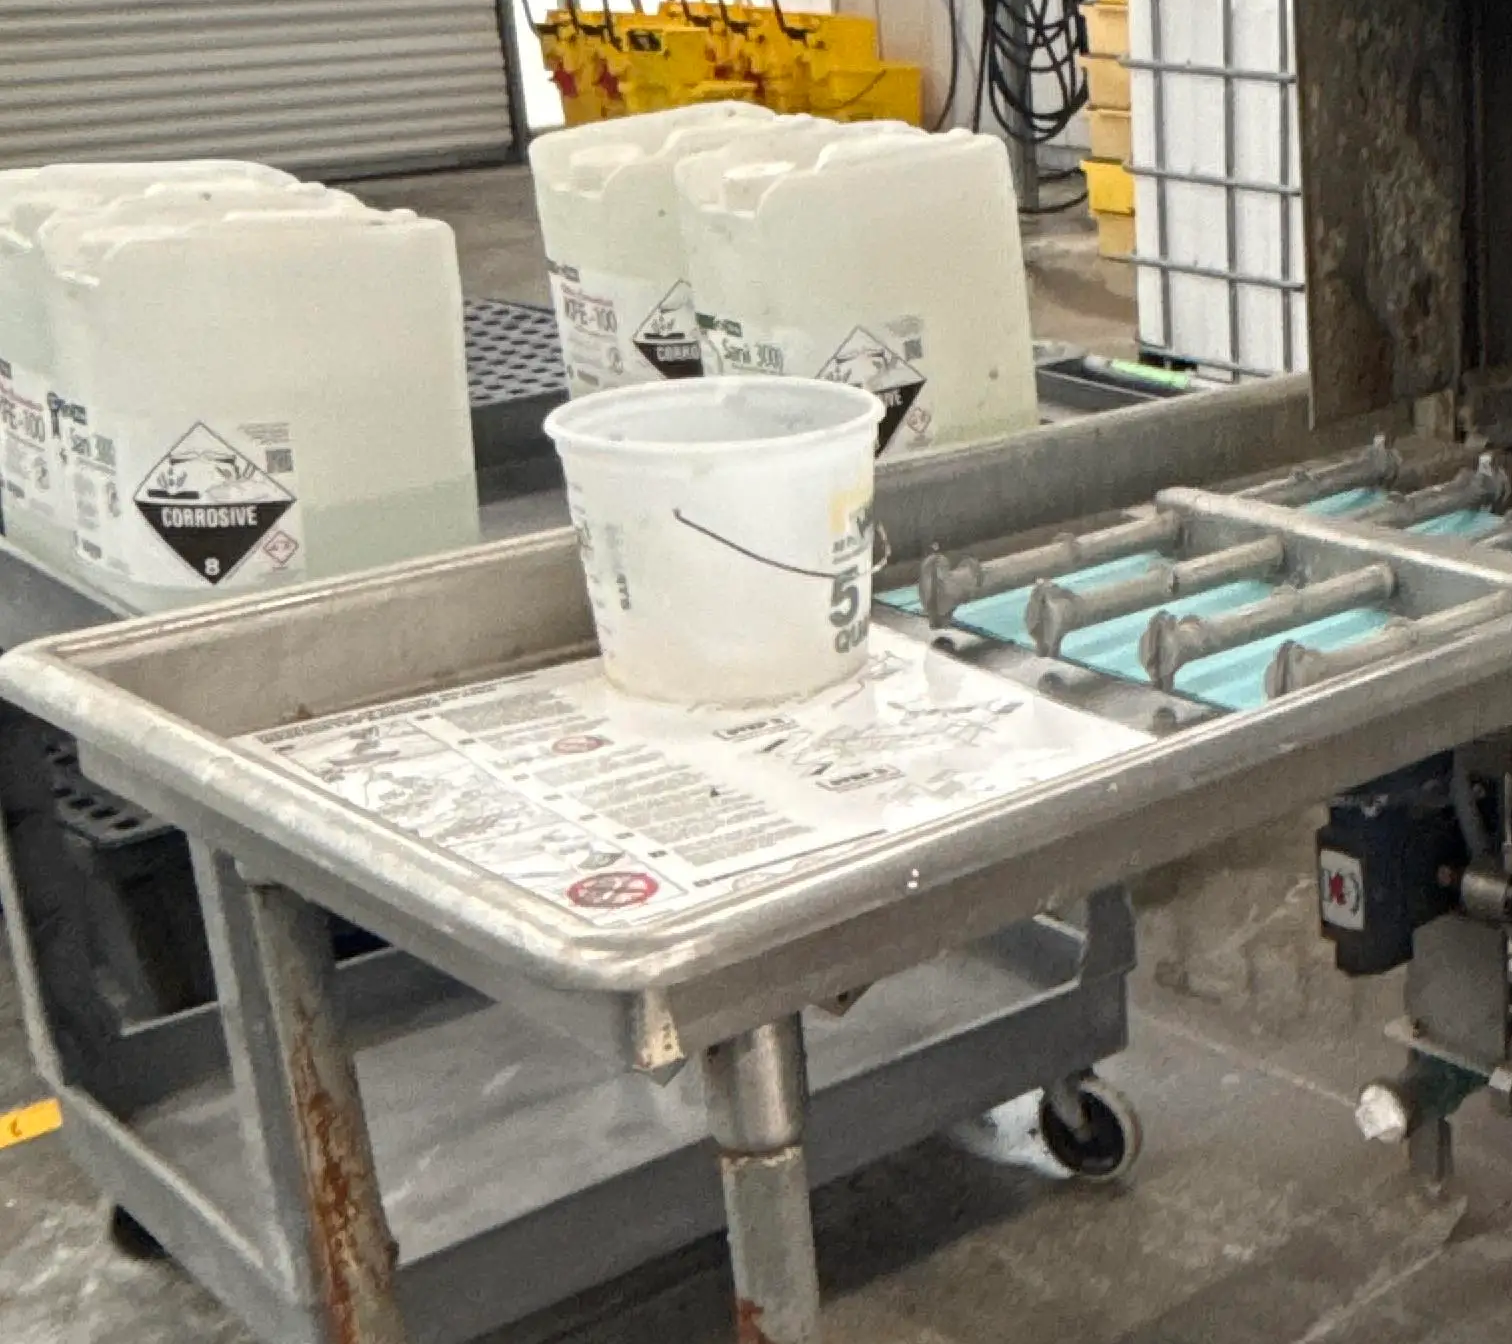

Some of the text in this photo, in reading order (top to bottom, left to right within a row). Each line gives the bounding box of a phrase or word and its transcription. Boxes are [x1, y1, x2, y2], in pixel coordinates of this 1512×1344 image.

[656, 342, 701, 362] CORRO
[160, 505, 258, 529] CORROSIVE
[204, 557, 220, 576] 8
[829, 563, 860, 628] 5
[834, 618, 869, 654] QUA
